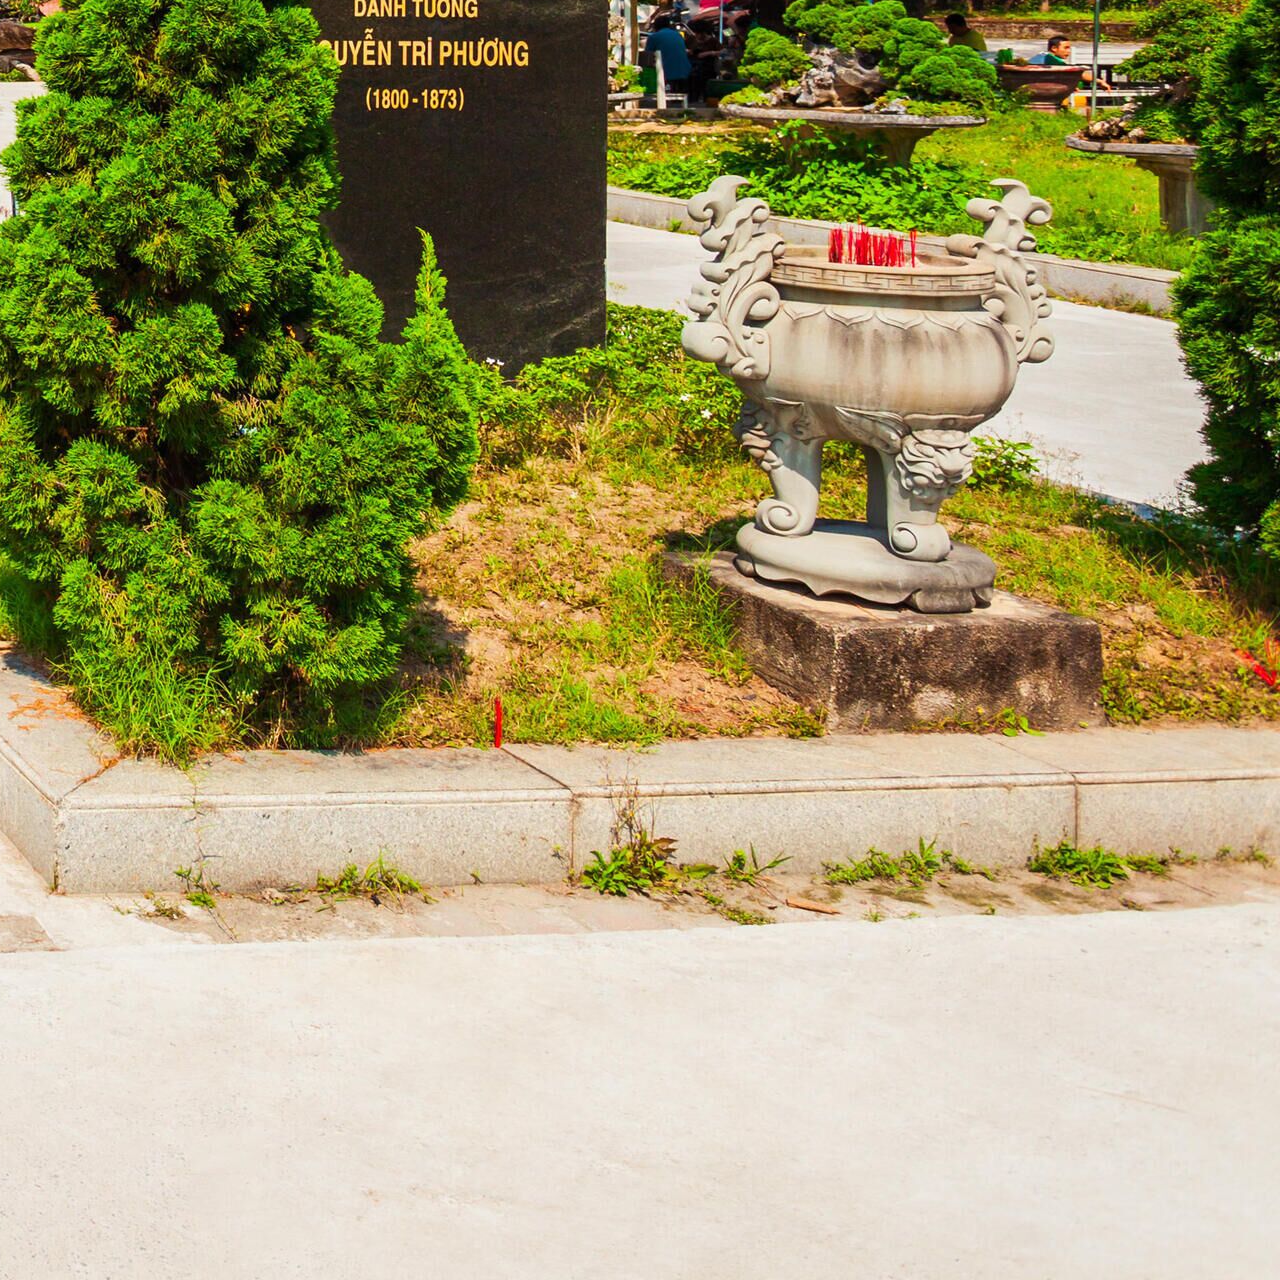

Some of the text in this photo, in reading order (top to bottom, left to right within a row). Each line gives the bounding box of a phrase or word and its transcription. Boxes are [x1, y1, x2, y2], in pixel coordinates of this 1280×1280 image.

[316, 27, 393, 67] UYỄN
[439, 36, 529, 67] PHƯƠNG
[365, 87, 409, 111] (1800
[421, 87, 465, 111] 1873)
